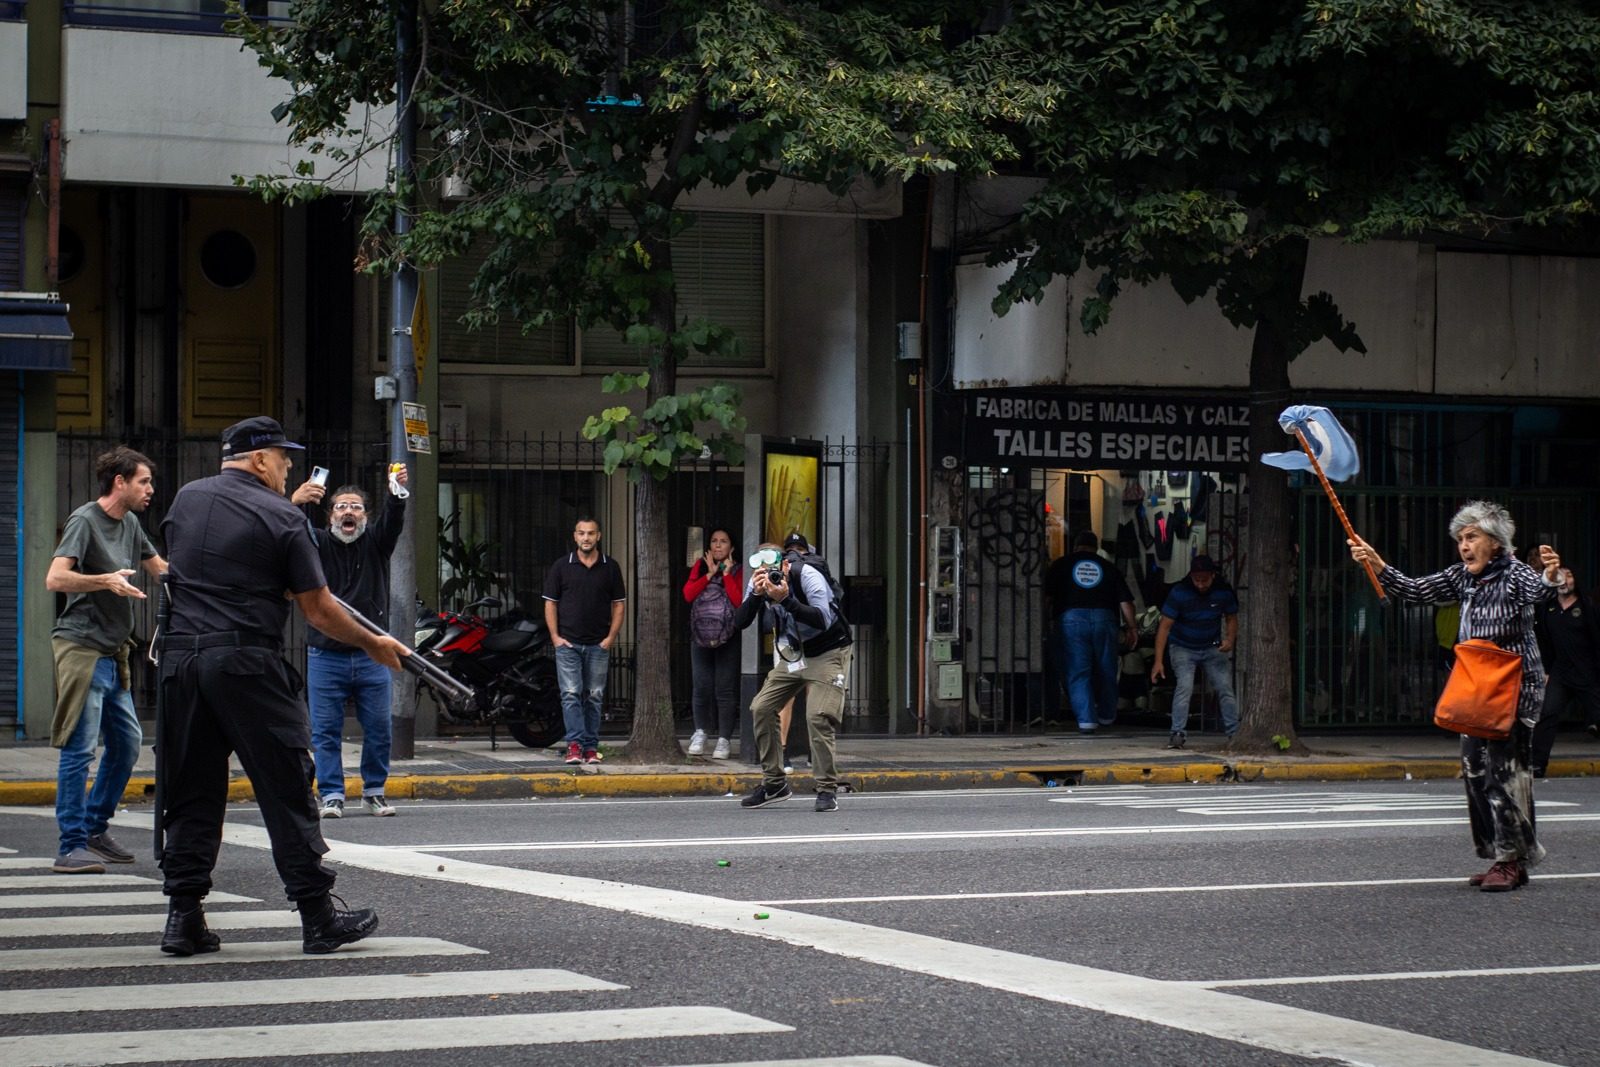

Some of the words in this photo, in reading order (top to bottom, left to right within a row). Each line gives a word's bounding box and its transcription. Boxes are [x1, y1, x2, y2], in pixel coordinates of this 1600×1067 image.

[976, 397, 1062, 420] FABRICA
[1067, 402, 1094, 421] DE
[1099, 402, 1177, 424] MALLAS
[1183, 406, 1196, 424] Y
[1202, 407, 1250, 426] CALZ
[994, 429, 1093, 459] TALLES
